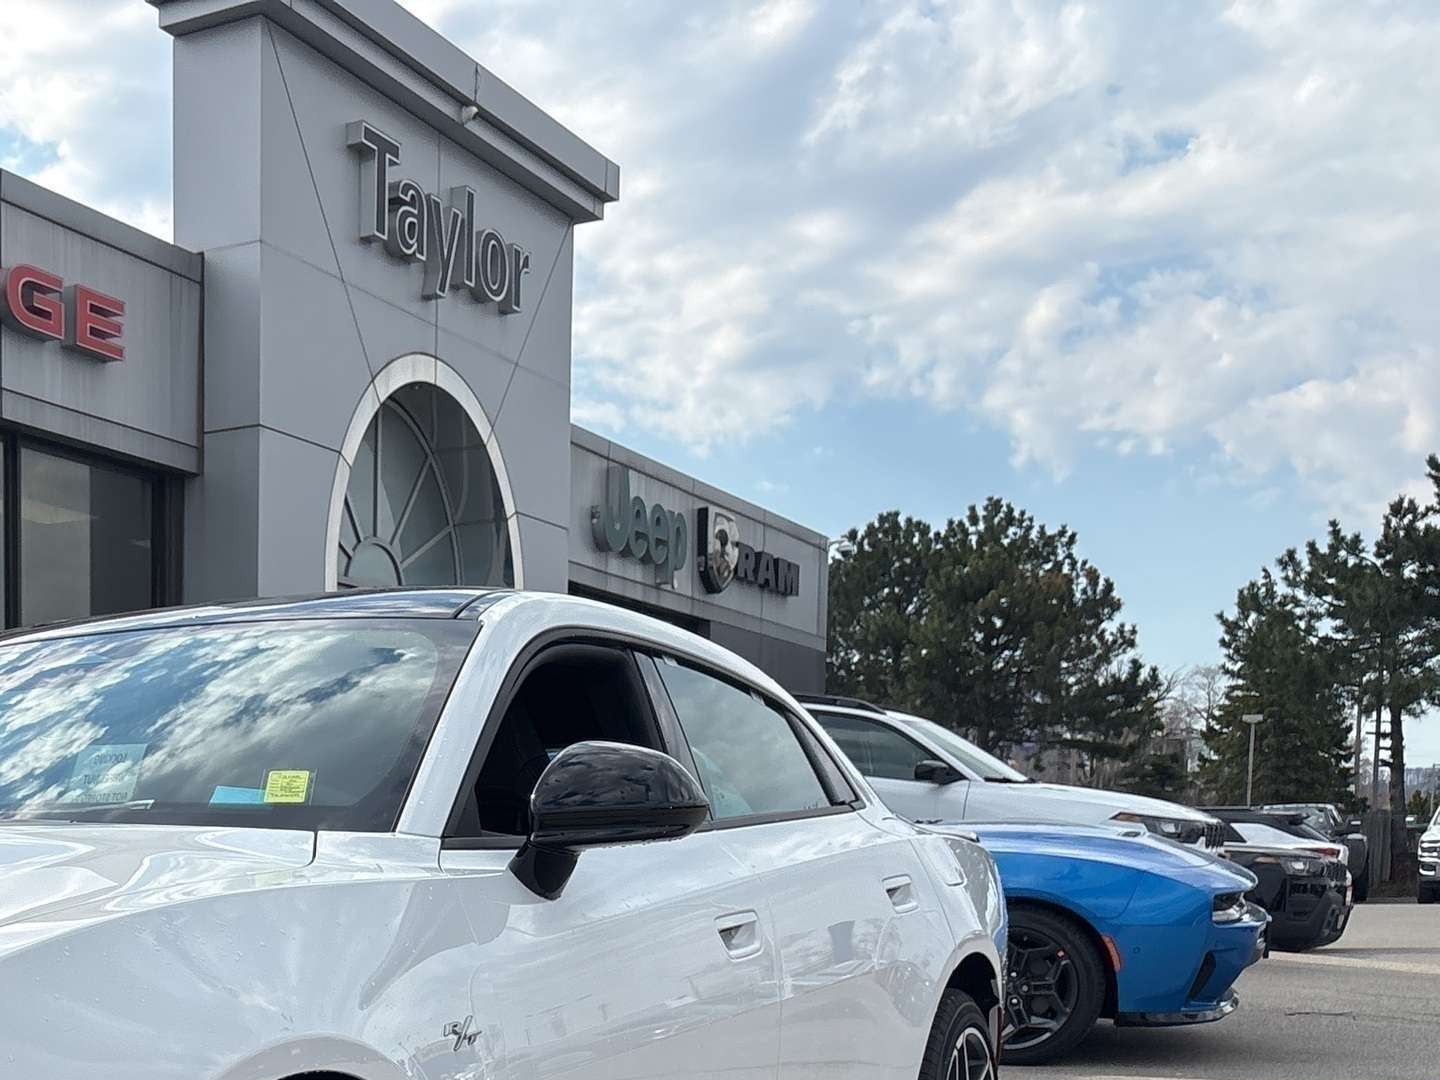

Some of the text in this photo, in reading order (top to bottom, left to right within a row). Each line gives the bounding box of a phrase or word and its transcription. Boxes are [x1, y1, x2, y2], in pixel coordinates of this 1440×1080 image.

[348, 120, 531, 314] Taylor
[592, 465, 688, 590] Jeep
[735, 541, 800, 596] RAM
